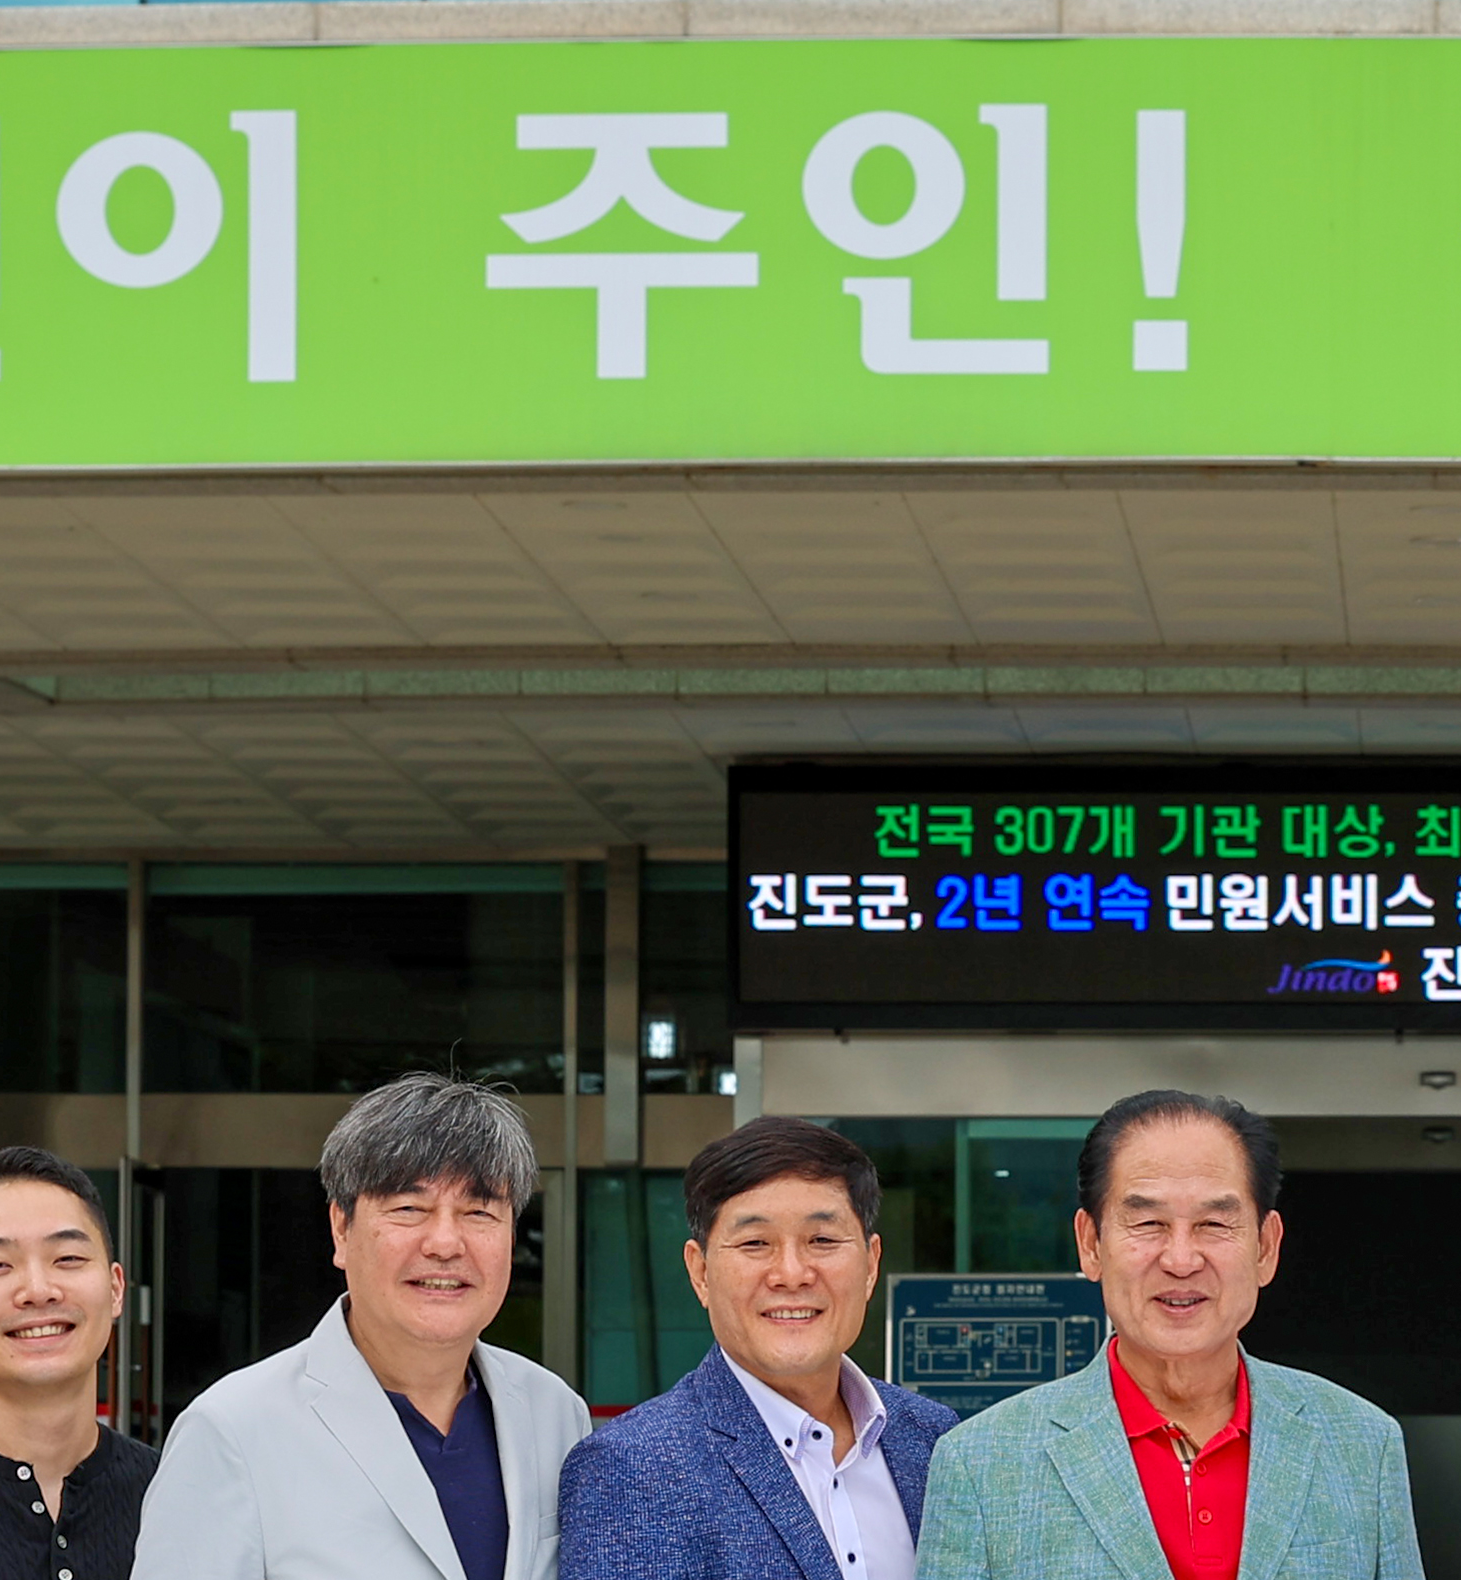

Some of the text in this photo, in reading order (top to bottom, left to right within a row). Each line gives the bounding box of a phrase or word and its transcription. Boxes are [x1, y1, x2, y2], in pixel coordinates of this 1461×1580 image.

[486, 104, 1188, 379] 주인!
[875, 805, 974, 858] 전국
[995, 806, 1135, 858] 307개
[1160, 806, 1261, 858] 기관
[1283, 806, 1395, 858] 대상,
[747, 873, 923, 931] 진도군,
[935, 873, 1023, 931] 2년
[1043, 873, 1152, 931] 연속
[1164, 874, 1435, 931] 민원서비스
[1266, 963, 1376, 995] Jindo
